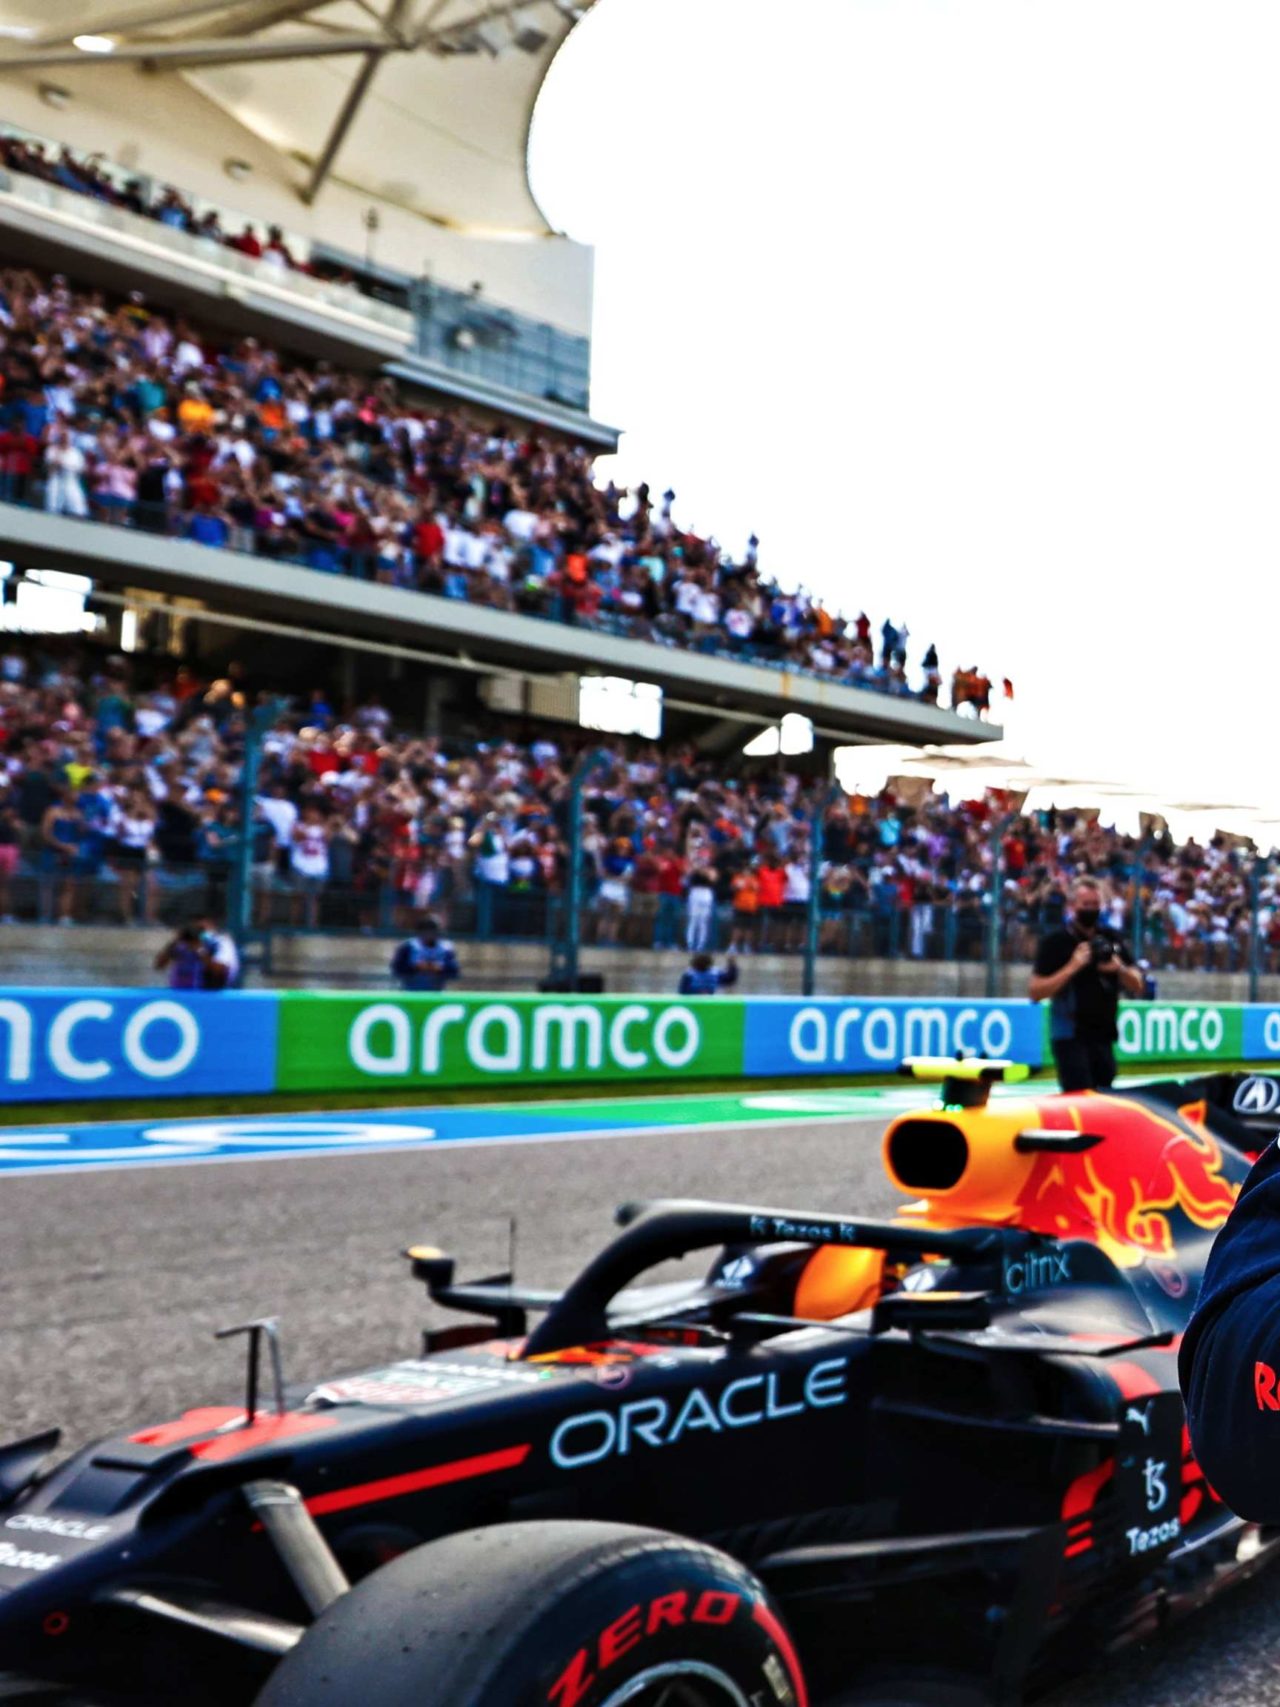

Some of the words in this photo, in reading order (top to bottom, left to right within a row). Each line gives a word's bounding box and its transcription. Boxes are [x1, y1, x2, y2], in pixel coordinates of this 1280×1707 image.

[349, 1003, 700, 1076] aramco
[789, 1006, 1011, 1062] aramco
[1116, 1008, 1223, 1054] amco
[551, 1357, 848, 1468] ORACLE
[1125, 1518, 1181, 1556] Tezos
[547, 1589, 742, 1707] ZERO
